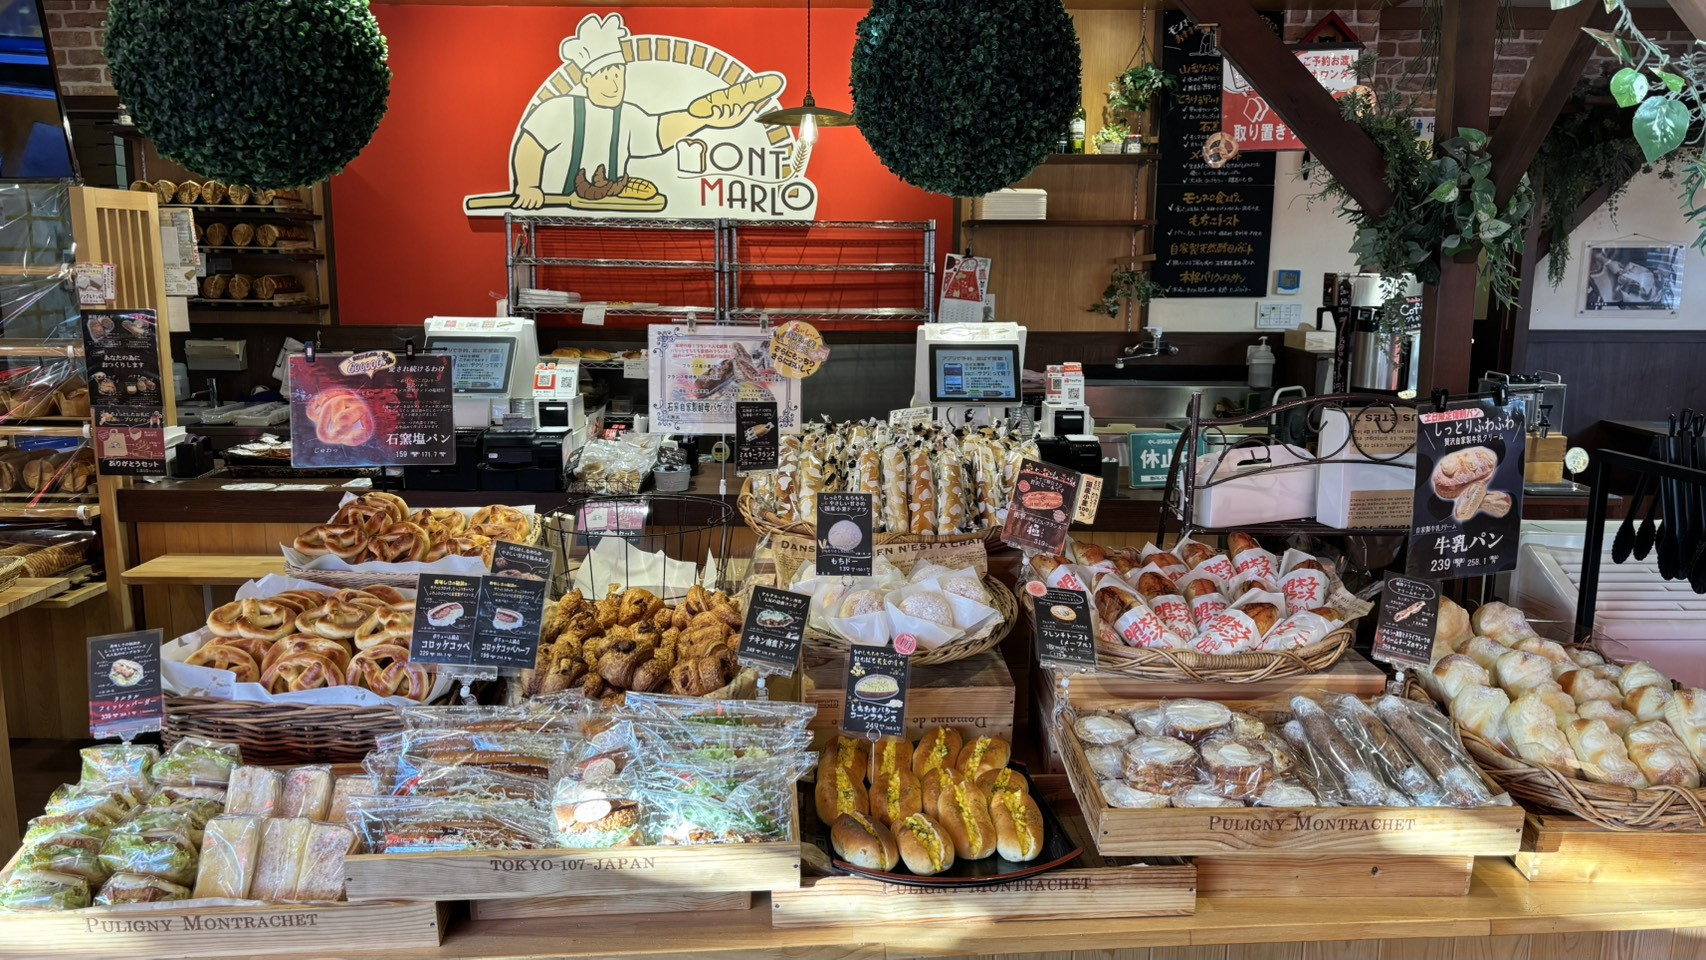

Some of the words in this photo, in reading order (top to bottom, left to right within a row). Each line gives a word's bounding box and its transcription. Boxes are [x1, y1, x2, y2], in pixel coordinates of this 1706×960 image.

[700, 178, 815, 216] MARLO
[388, 365, 445, 373] 愛され続けるわけ
[1434, 418, 1515, 436] しっとりふわふわ
[385, 433, 451, 446] 石窯塩パン
[781, 540, 816, 553] DANS
[1433, 532, 1504, 555] 牛乳パン
[830, 557, 859, 566] もちドー
[1430, 558, 1451, 572] 239
[1282, 577, 1321, 595] 明太子
[1154, 602, 1192, 616] 明太子
[1124, 612, 1159, 641] 明太子
[1042, 630, 1089, 641] フレンチトースト
[421, 640, 471, 651] コロッケコッペ
[481, 642, 531, 655] コロッケコッペハーフ
[748, 634, 797, 651] チキン南蛮ドッグ
[99, 698, 157, 712] フィッシュバーガー
[851, 704, 898, 715] しあわせバター
[850, 712, 897, 723] コーンフランス
[912, 717, 927, 729] de
[930, 717, 988, 729] Domaine
[489, 857, 656, 872] TOKYO-107-JAPAN
[85, 915, 171, 934] PULIGNY
[183, 913, 318, 932] MONTRACHET
